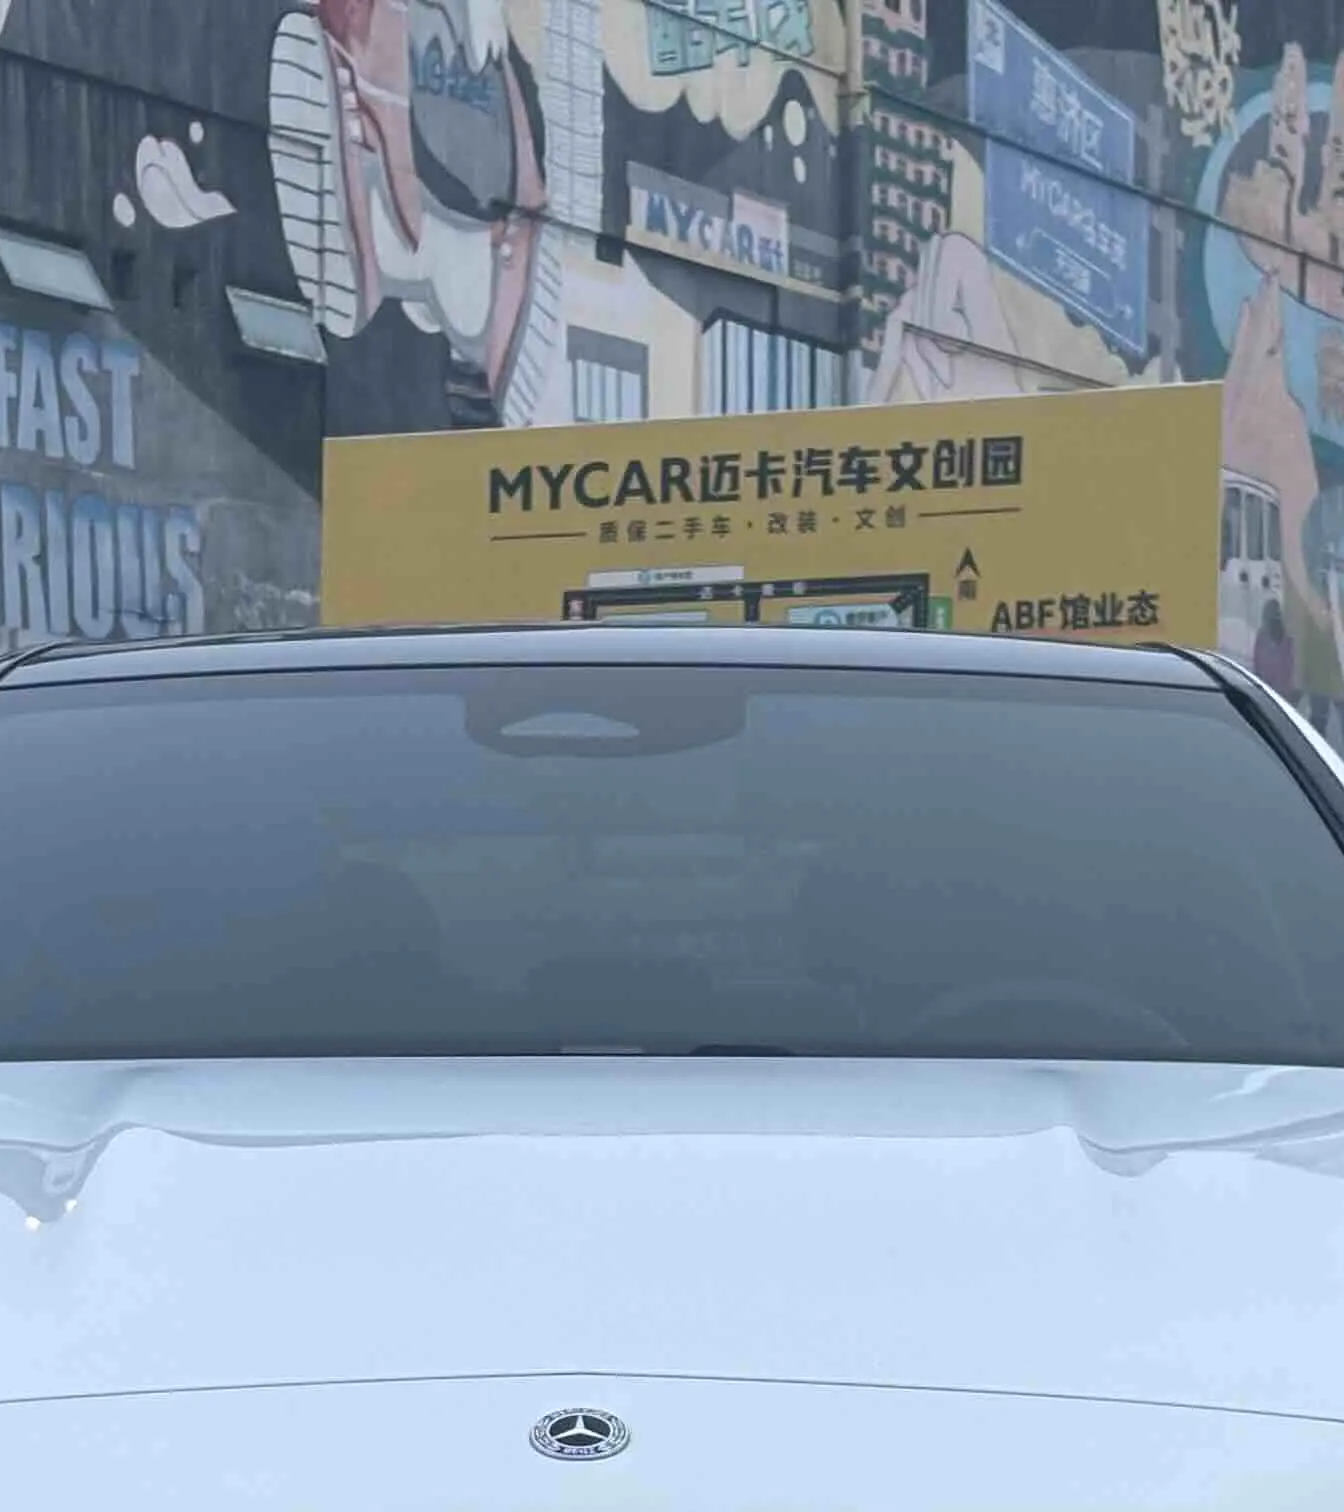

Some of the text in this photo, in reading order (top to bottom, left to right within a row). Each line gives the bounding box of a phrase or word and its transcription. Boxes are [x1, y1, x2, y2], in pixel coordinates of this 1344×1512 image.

[488, 436, 1024, 514] MYCAR迈卡汽车文创园
[991, 589, 1160, 633] ABF馆业态
